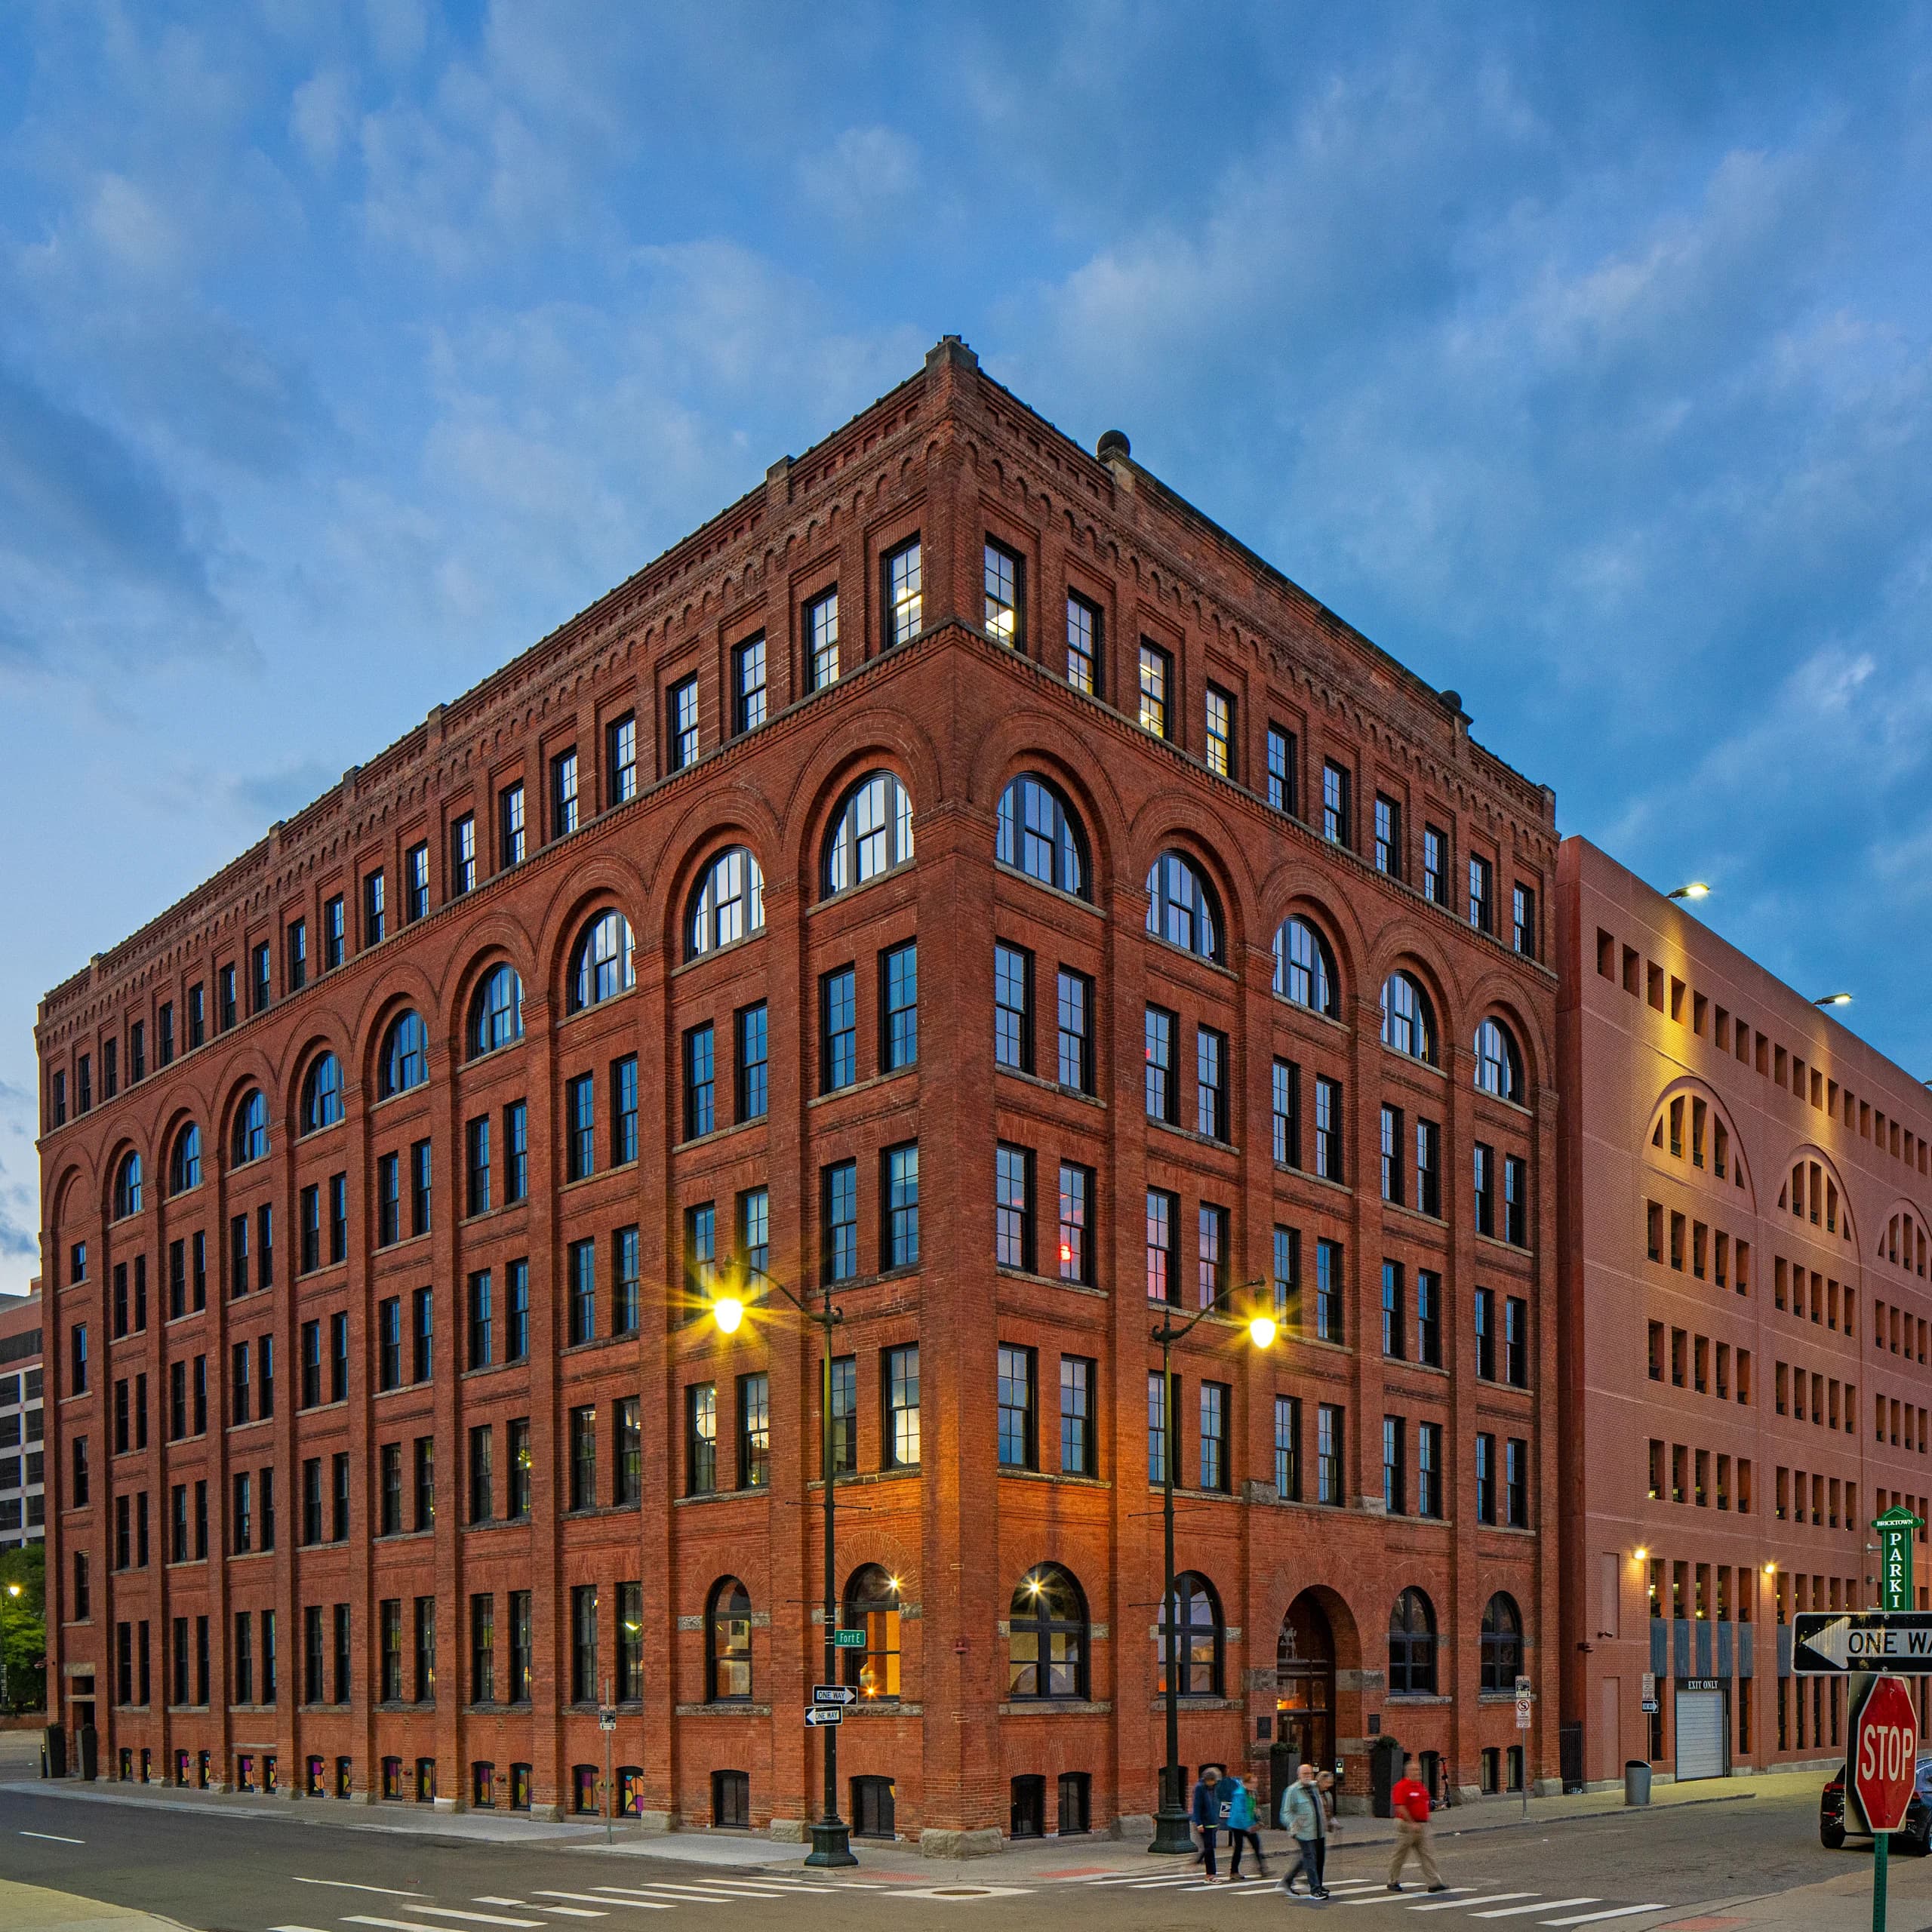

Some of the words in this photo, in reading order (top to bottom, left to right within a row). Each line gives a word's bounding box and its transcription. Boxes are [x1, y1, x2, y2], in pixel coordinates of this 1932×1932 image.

[1877, 1518, 1913, 1527] BRICKTOWN
[840, 1633, 854, 1643] Fort
[857, 1633, 860, 1643] E
[1848, 1632, 1897, 1654] ONE
[1688, 1681, 1702, 1689] EXIT
[1703, 1680, 1718, 1689] ONLY
[827, 1711, 838, 1719] WAY
[1861, 1724, 1914, 1782] STOP
